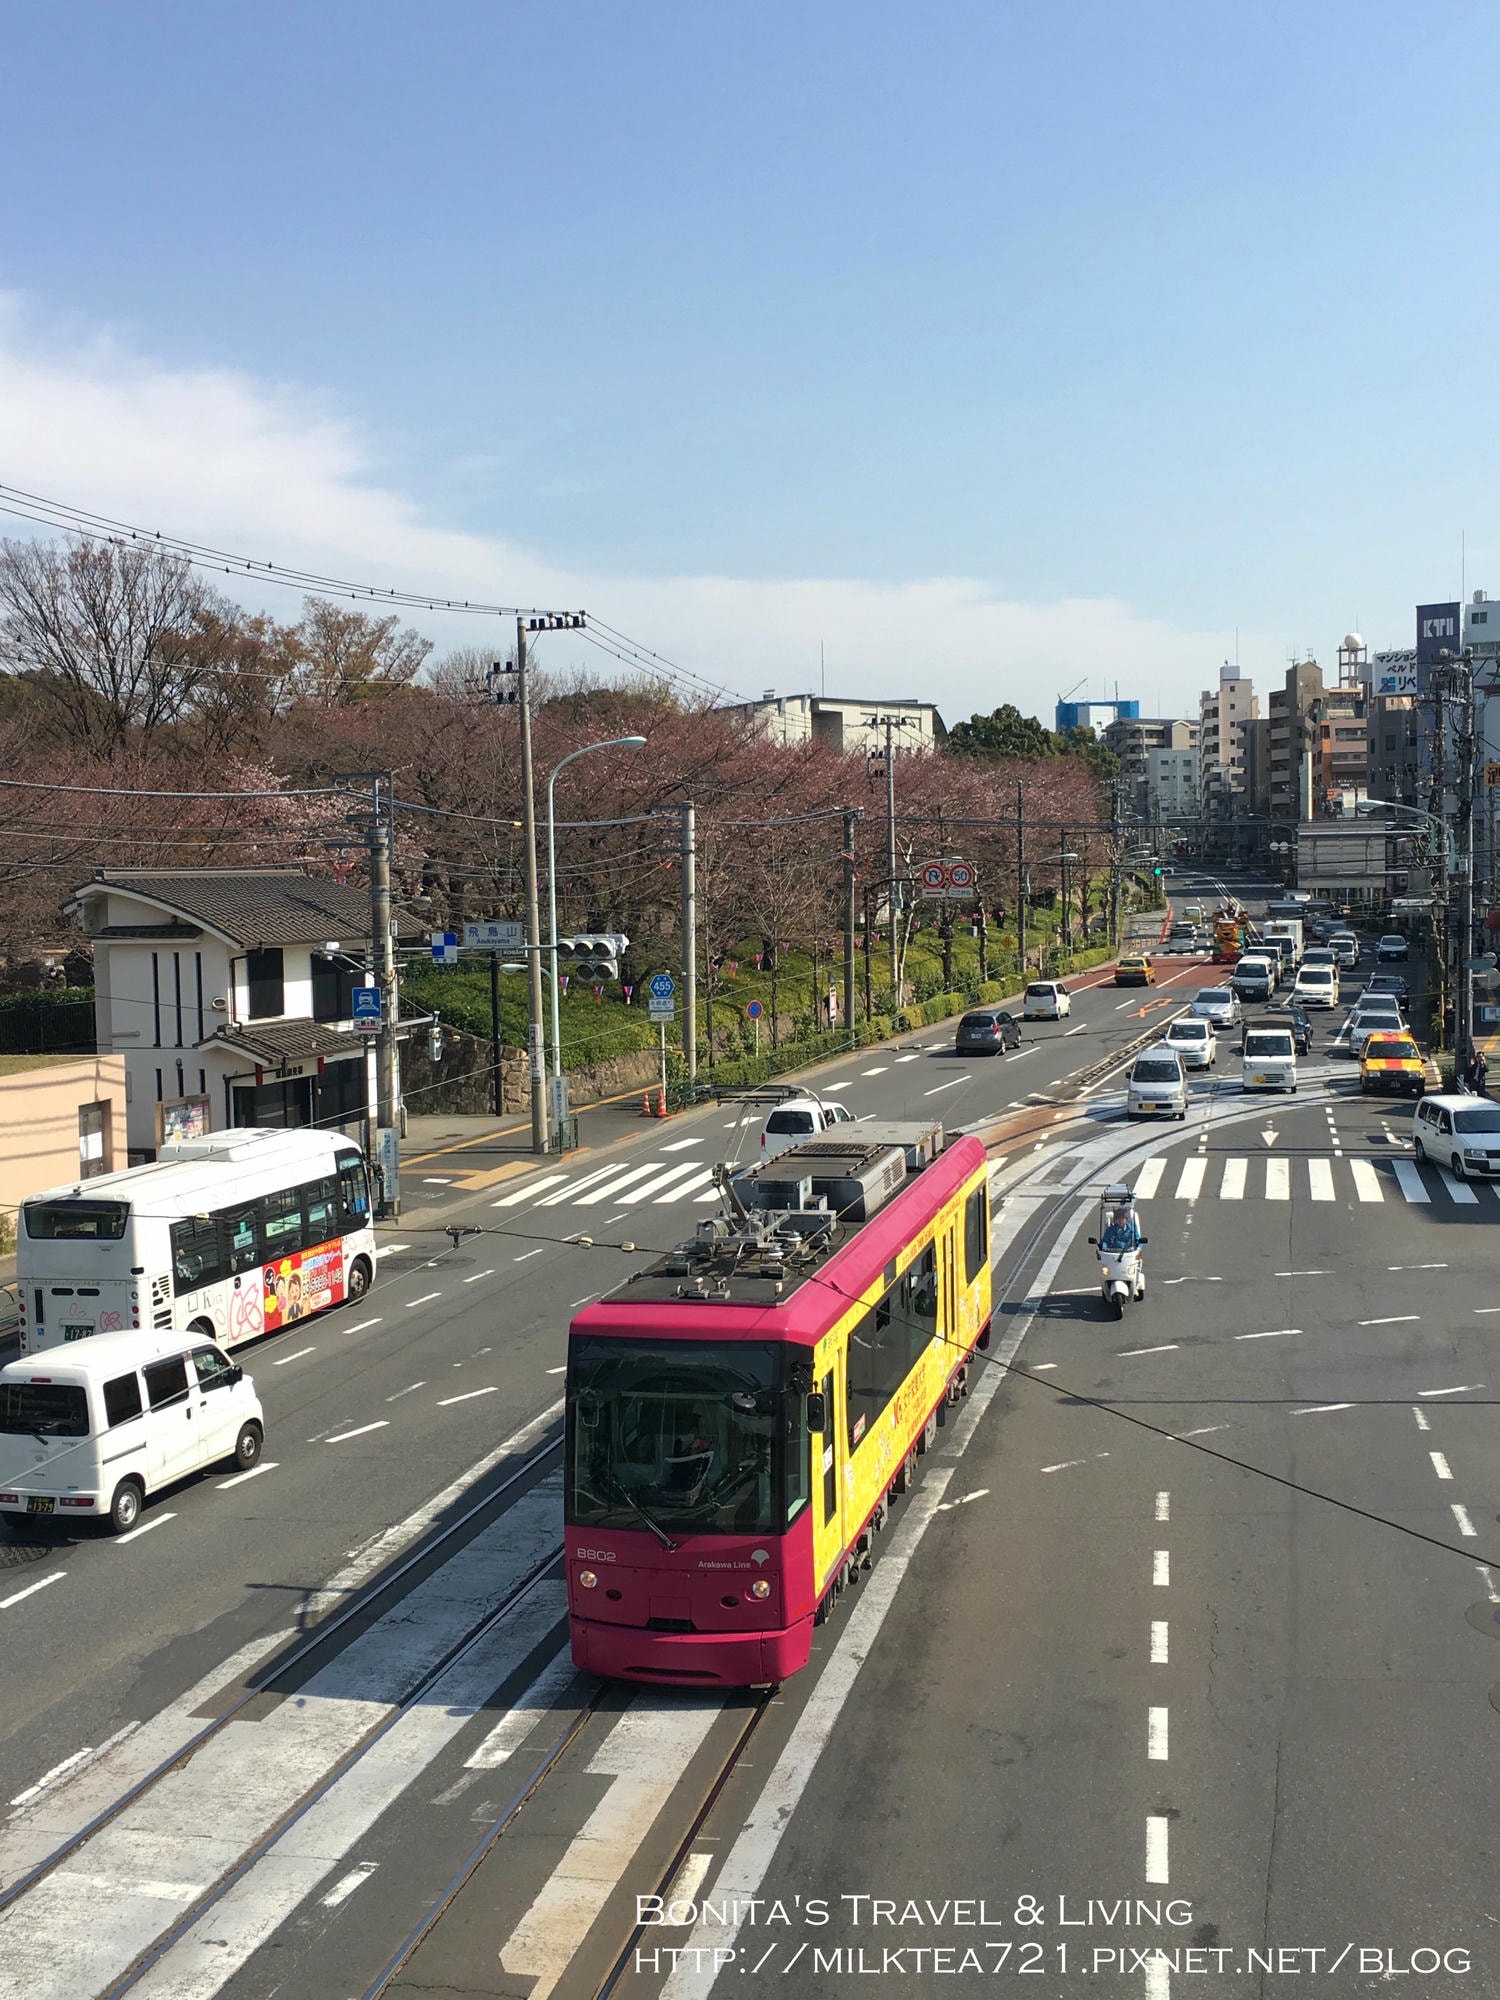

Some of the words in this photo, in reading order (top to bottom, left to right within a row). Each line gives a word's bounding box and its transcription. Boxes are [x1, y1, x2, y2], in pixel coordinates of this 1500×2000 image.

[468, 925, 518, 938] 飛鳥山
[653, 981, 671, 991] 455
[577, 1548, 617, 1563] 8802
[698, 1560, 731, 1569] Arakawa
